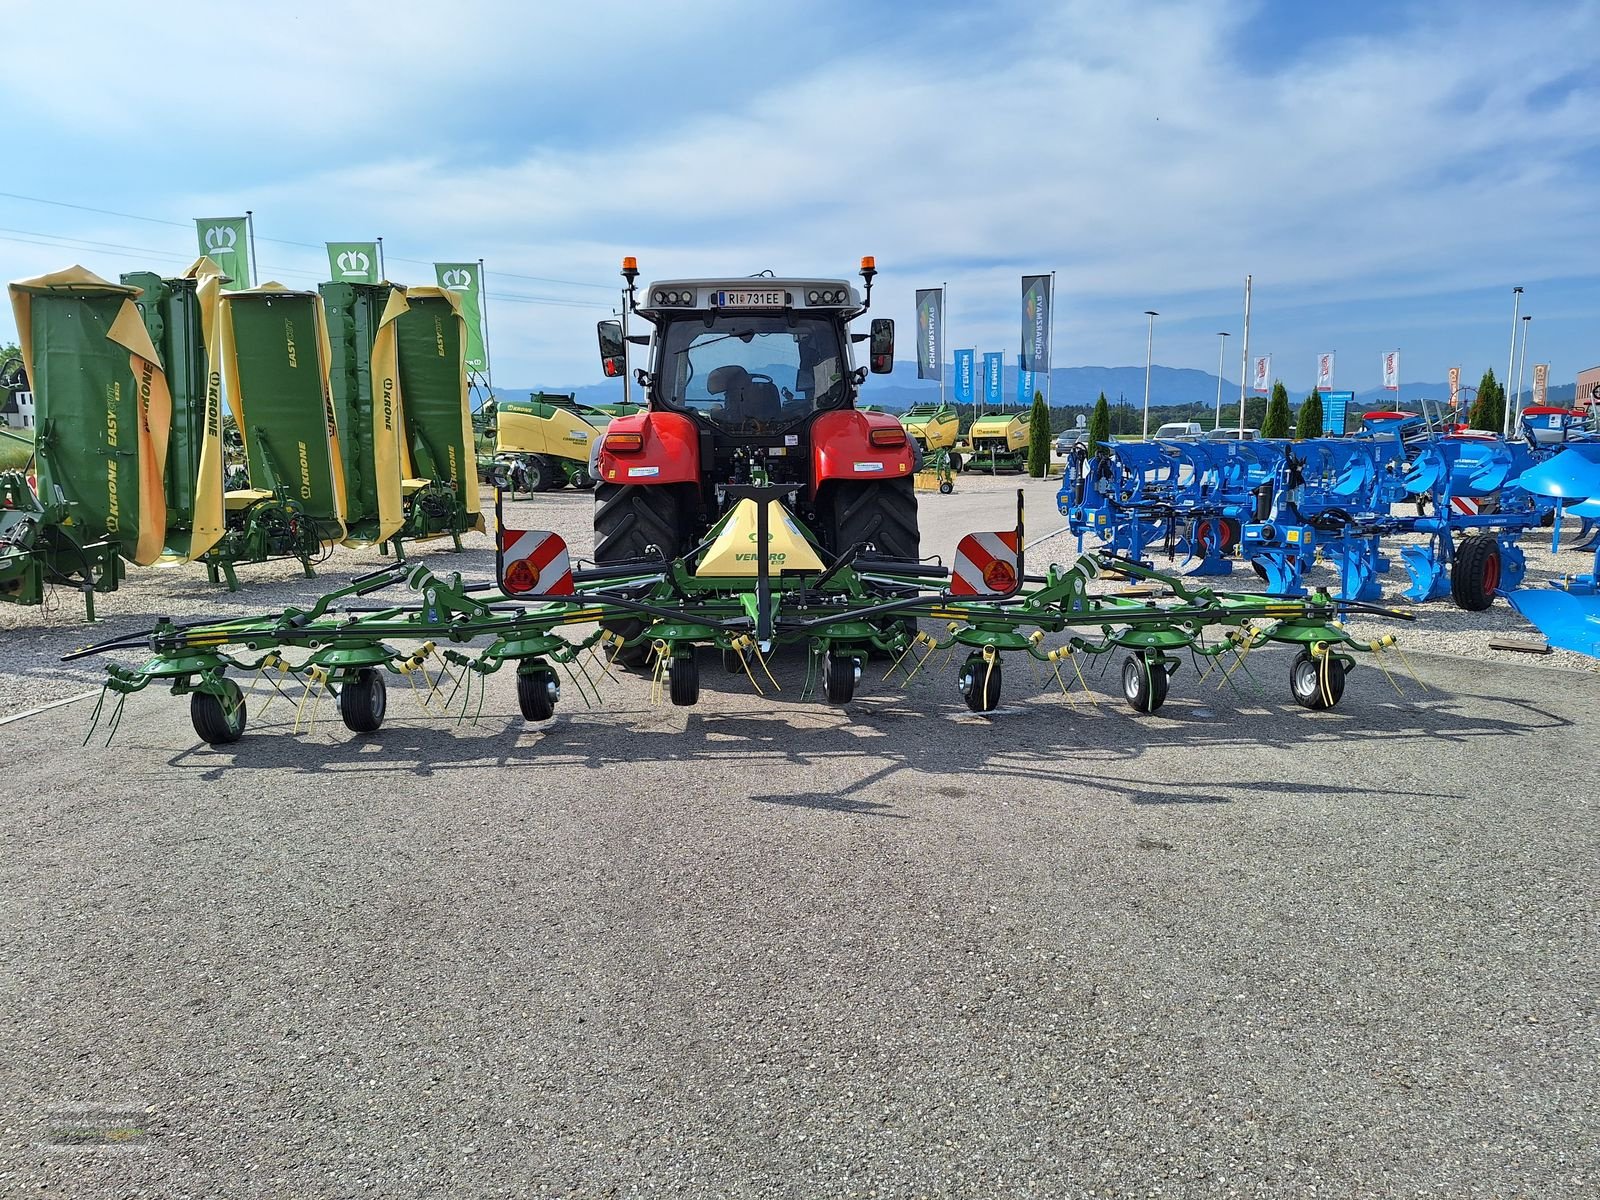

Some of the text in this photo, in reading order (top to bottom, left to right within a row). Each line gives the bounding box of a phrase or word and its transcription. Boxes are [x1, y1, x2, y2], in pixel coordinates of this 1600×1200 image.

[729, 293, 739, 304] RI
[106, 383, 117, 447] EASYCUT
[208, 387, 219, 437] KRONE
[384, 390, 393, 431] KRONE
[298, 441, 310, 485] KRONE
[108, 459, 119, 516] KRONE
[735, 553, 786, 561] VENRO
